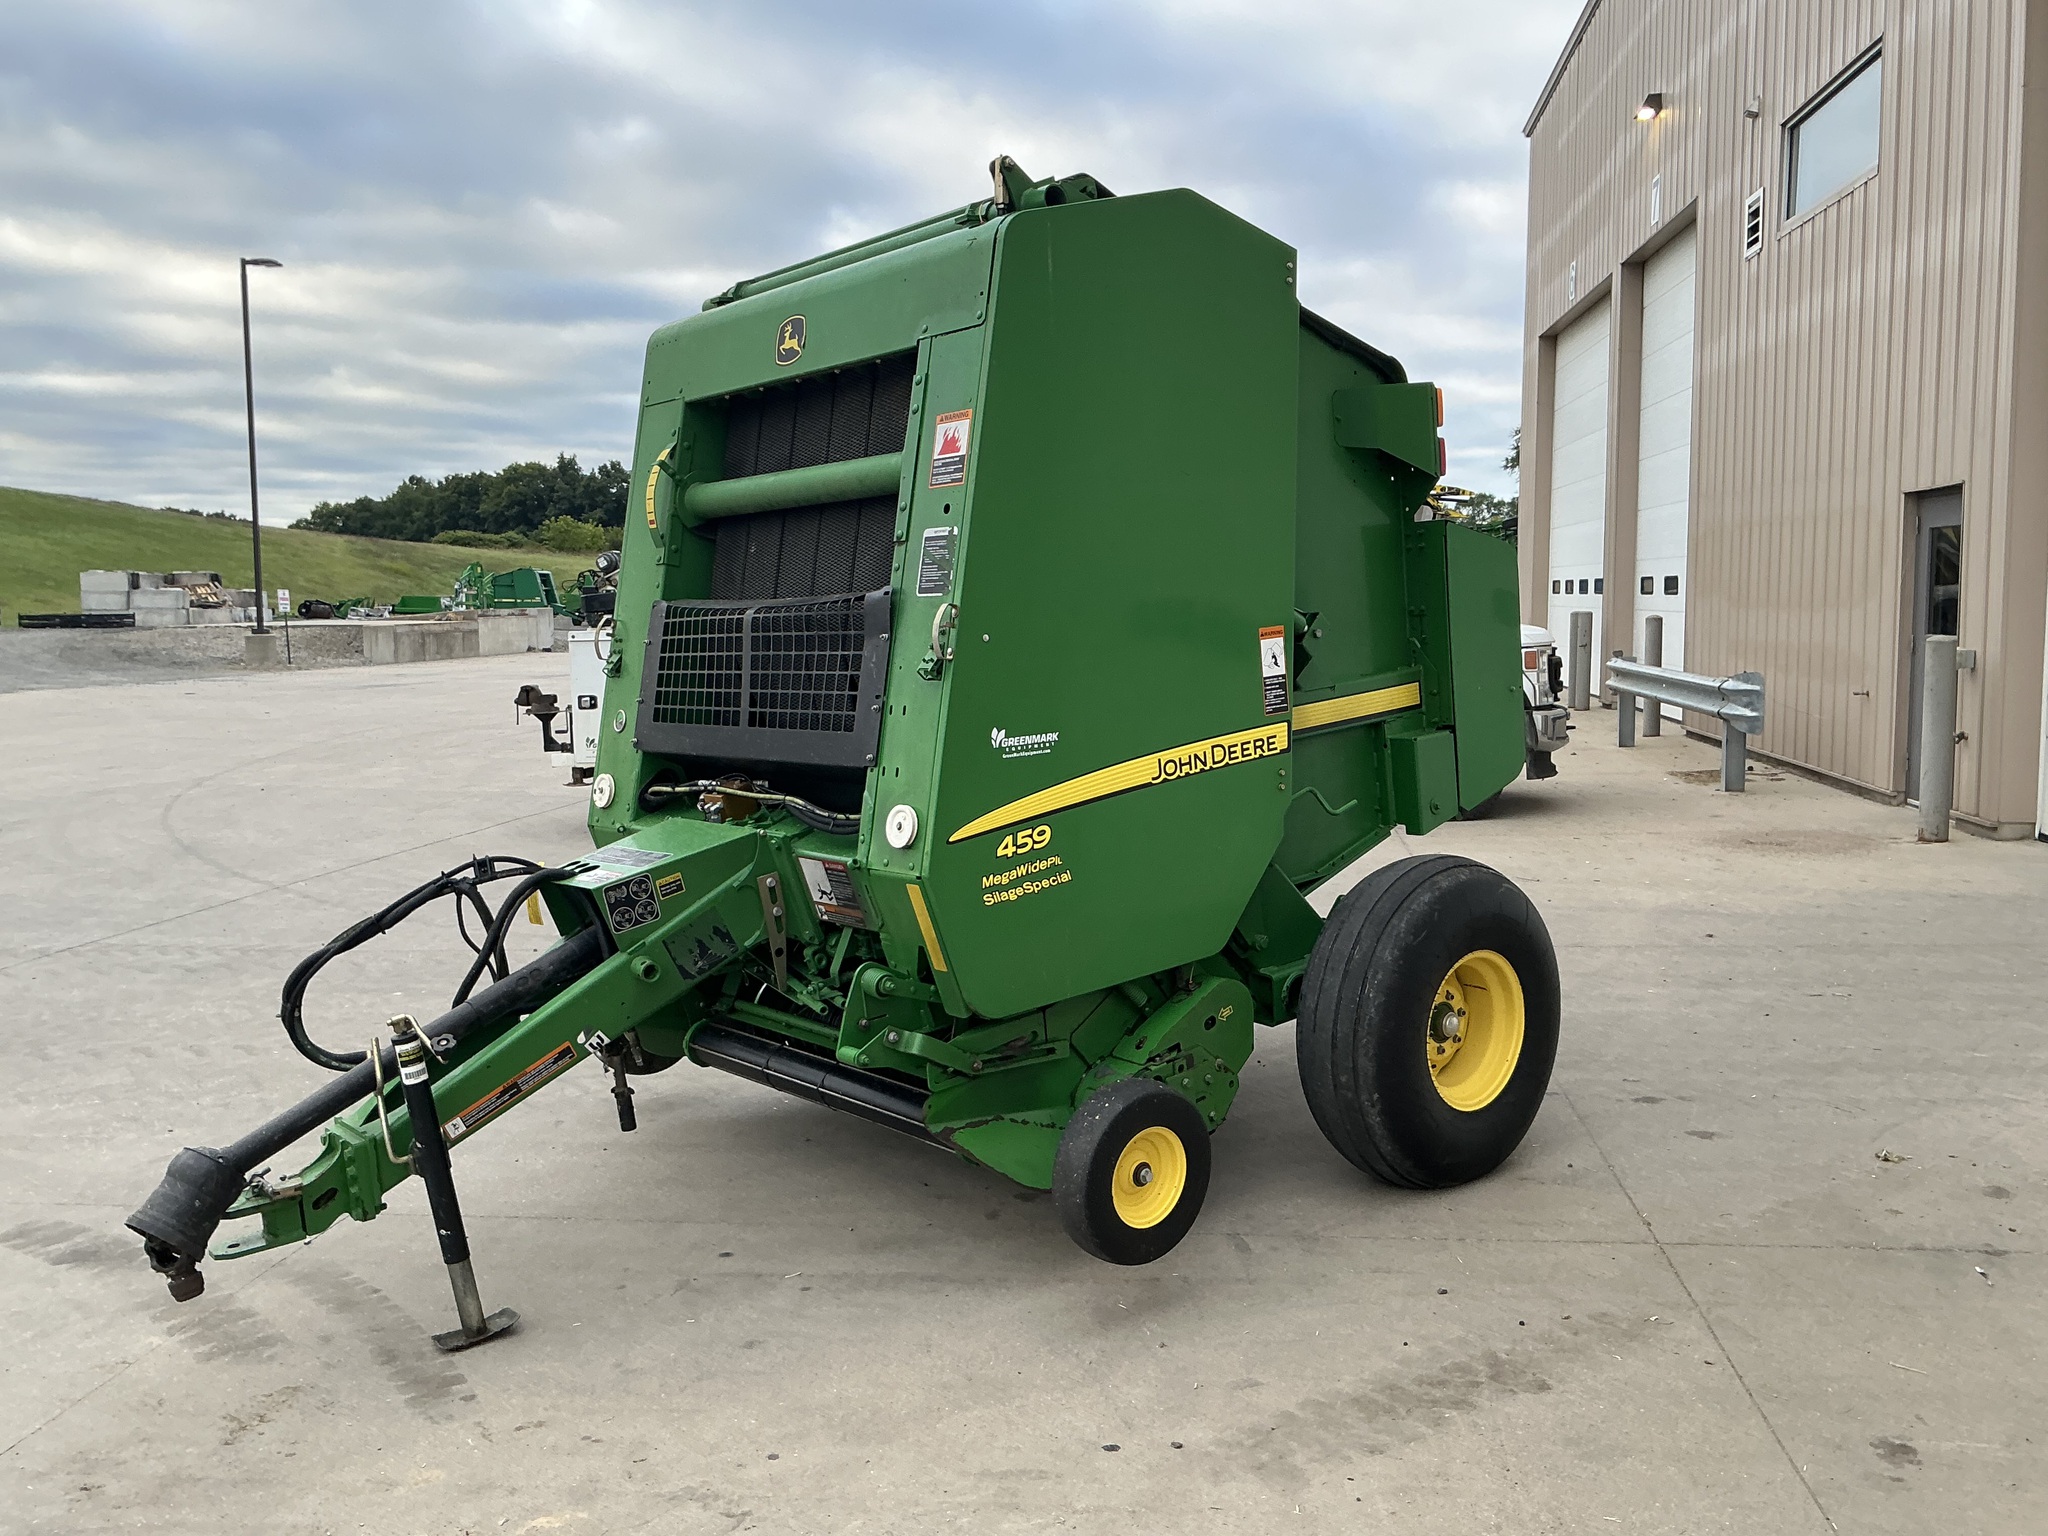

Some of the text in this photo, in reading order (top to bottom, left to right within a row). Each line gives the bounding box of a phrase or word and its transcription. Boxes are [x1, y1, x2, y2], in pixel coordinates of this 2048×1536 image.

[1651, 176, 1660, 224] 7
[944, 410, 969, 421] WARNING
[1001, 731, 1059, 747] GREENMARK
[1006, 742, 1055, 752] EQUIPMENT
[1151, 734, 1278, 781] JOHN DEERE
[996, 824, 1052, 858] 459
[983, 870, 1072, 906] SilageSpecial
